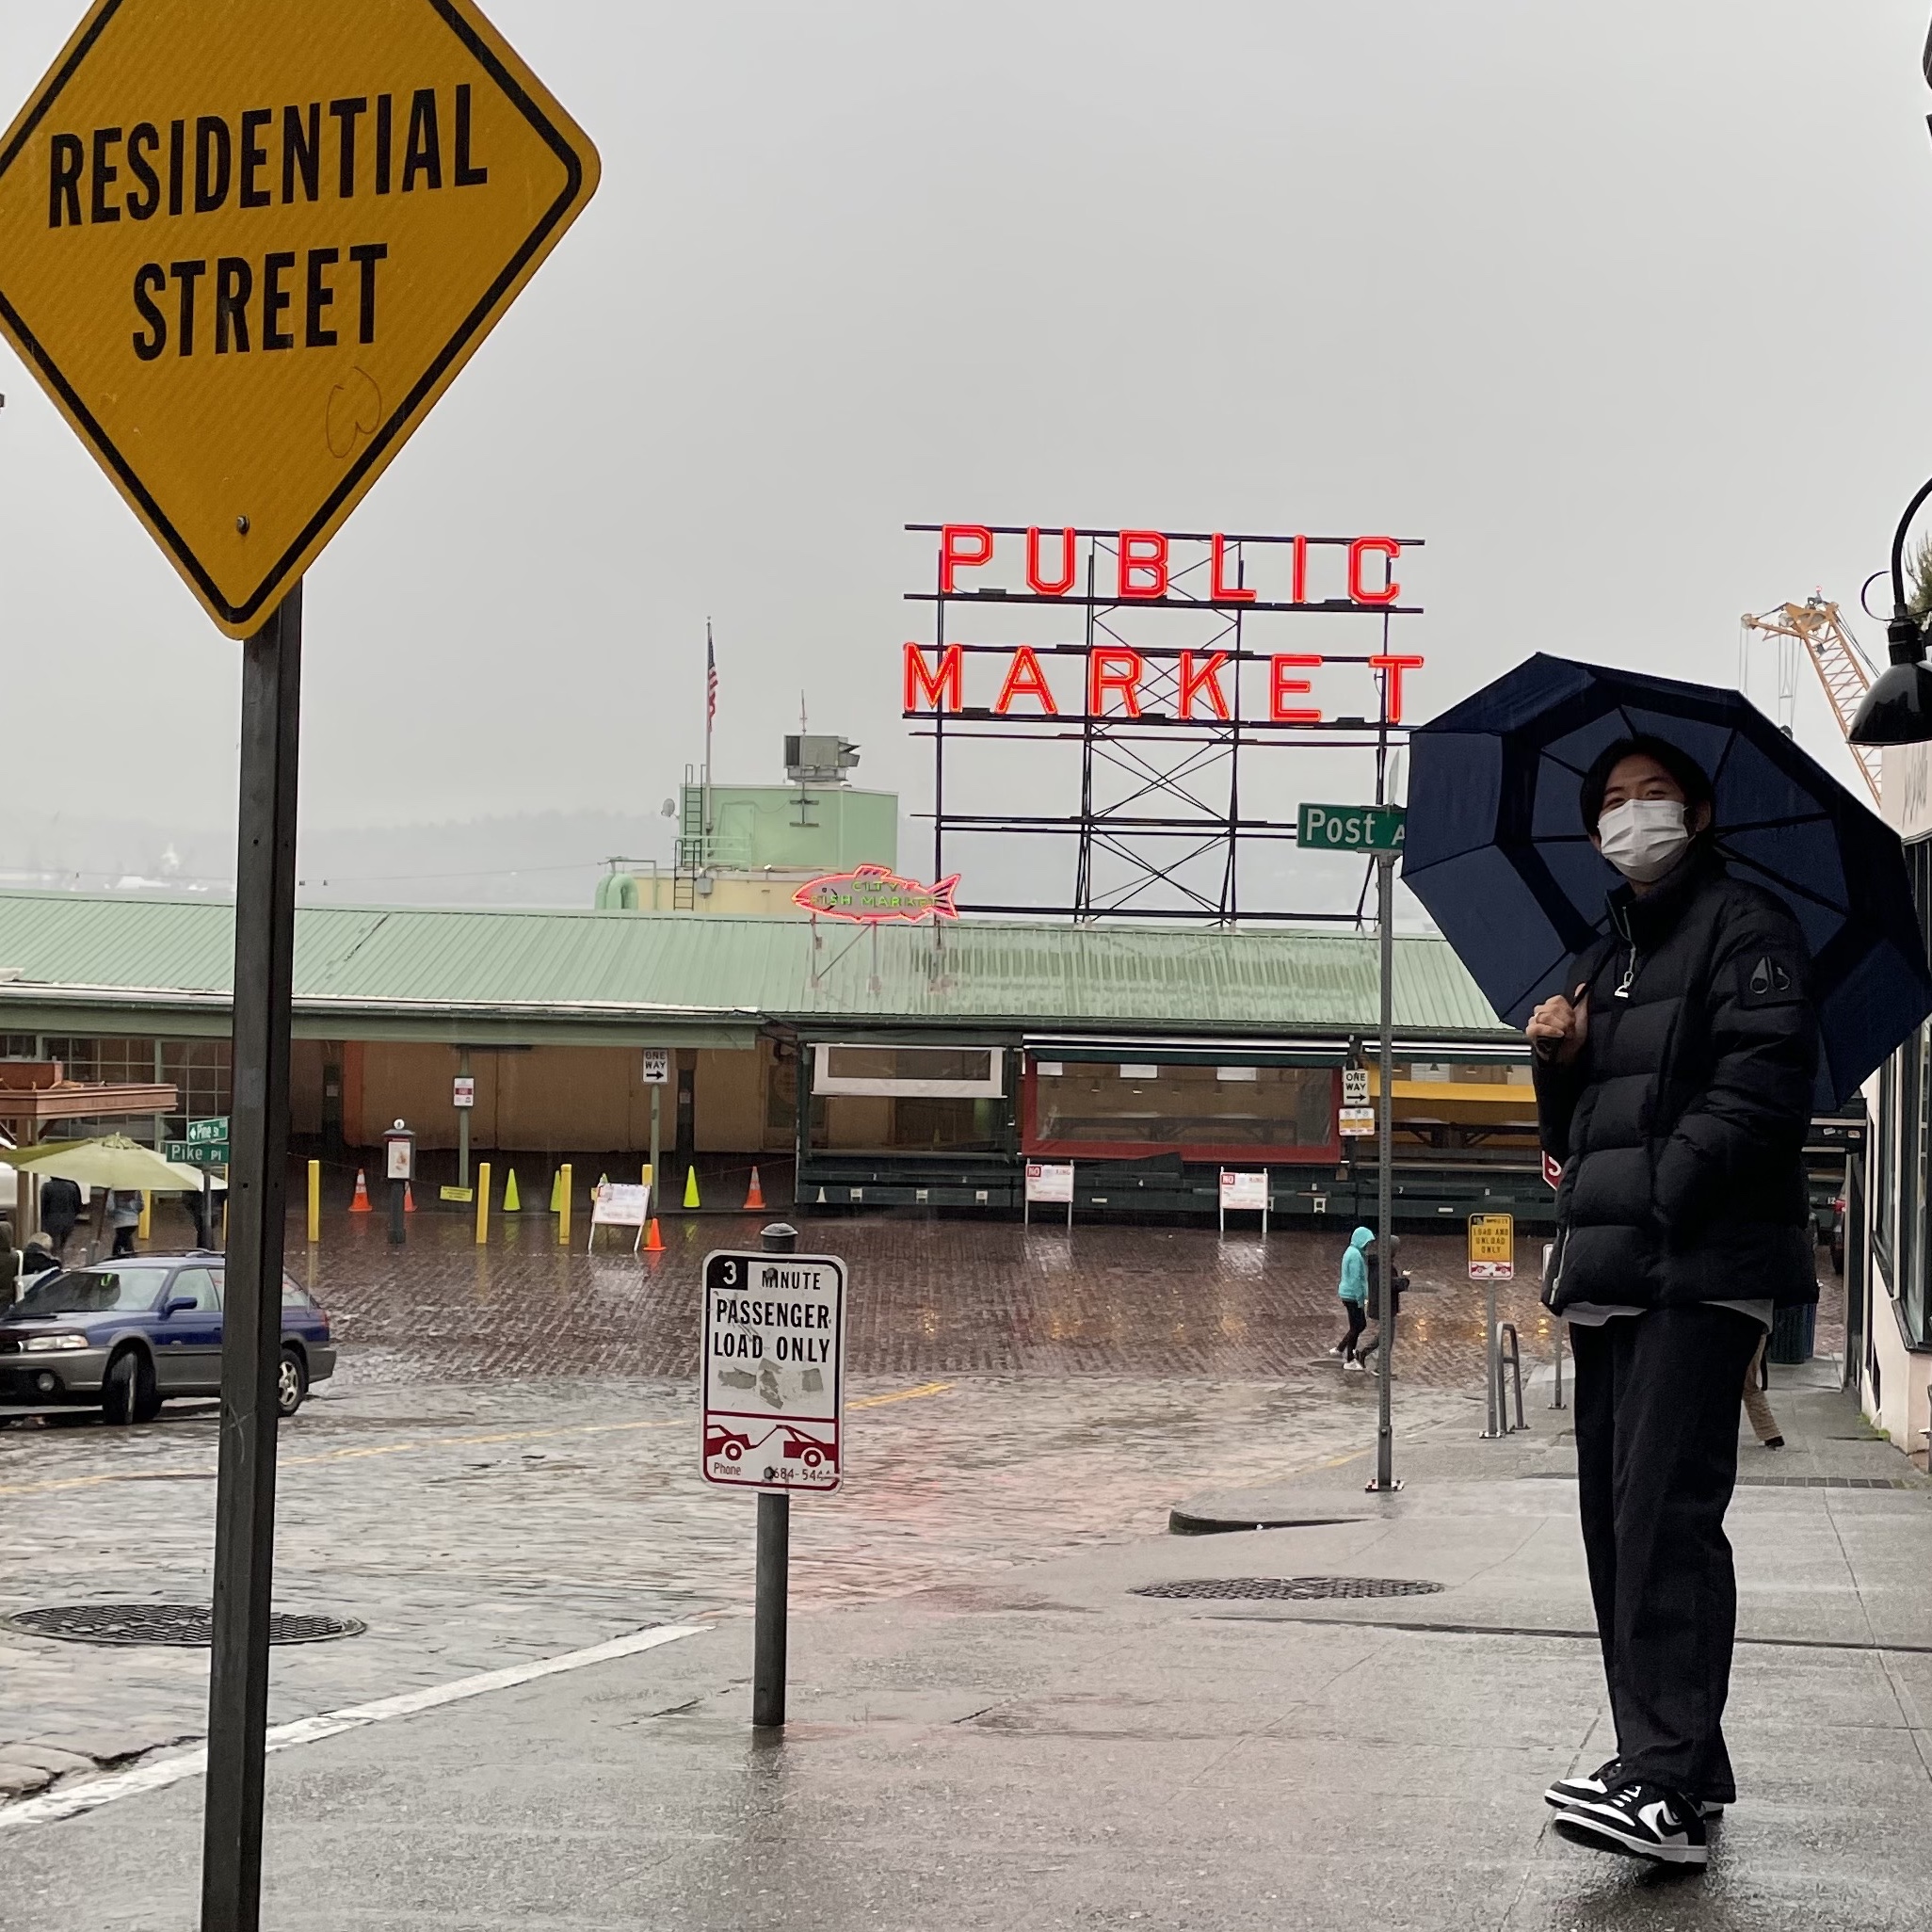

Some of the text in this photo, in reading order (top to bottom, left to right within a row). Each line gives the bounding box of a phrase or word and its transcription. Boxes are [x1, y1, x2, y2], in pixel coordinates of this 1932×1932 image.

[49, 84, 488, 228] RESIDENTIAL
[133, 243, 388, 361] STREET
[942, 524, 1401, 605] PUBLIC
[903, 642, 1425, 723] MARKET
[1306, 808, 1376, 845] Post
[852, 880, 897, 892] CITY
[861, 895, 937, 908] MARKET
[645, 1051, 666, 1060] ONE
[645, 1060, 666, 1070] WAY
[1345, 1072, 1366, 1082] ONE
[1345, 1083, 1366, 1091] WAY
[171, 1144, 222, 1161] Pike Pl
[722, 1261, 821, 1291] 3 MINUTE
[716, 1298, 829, 1329] PASSENGER
[714, 1331, 830, 1363] LOAD ONLY
[714, 1461, 742, 1476] Phone
